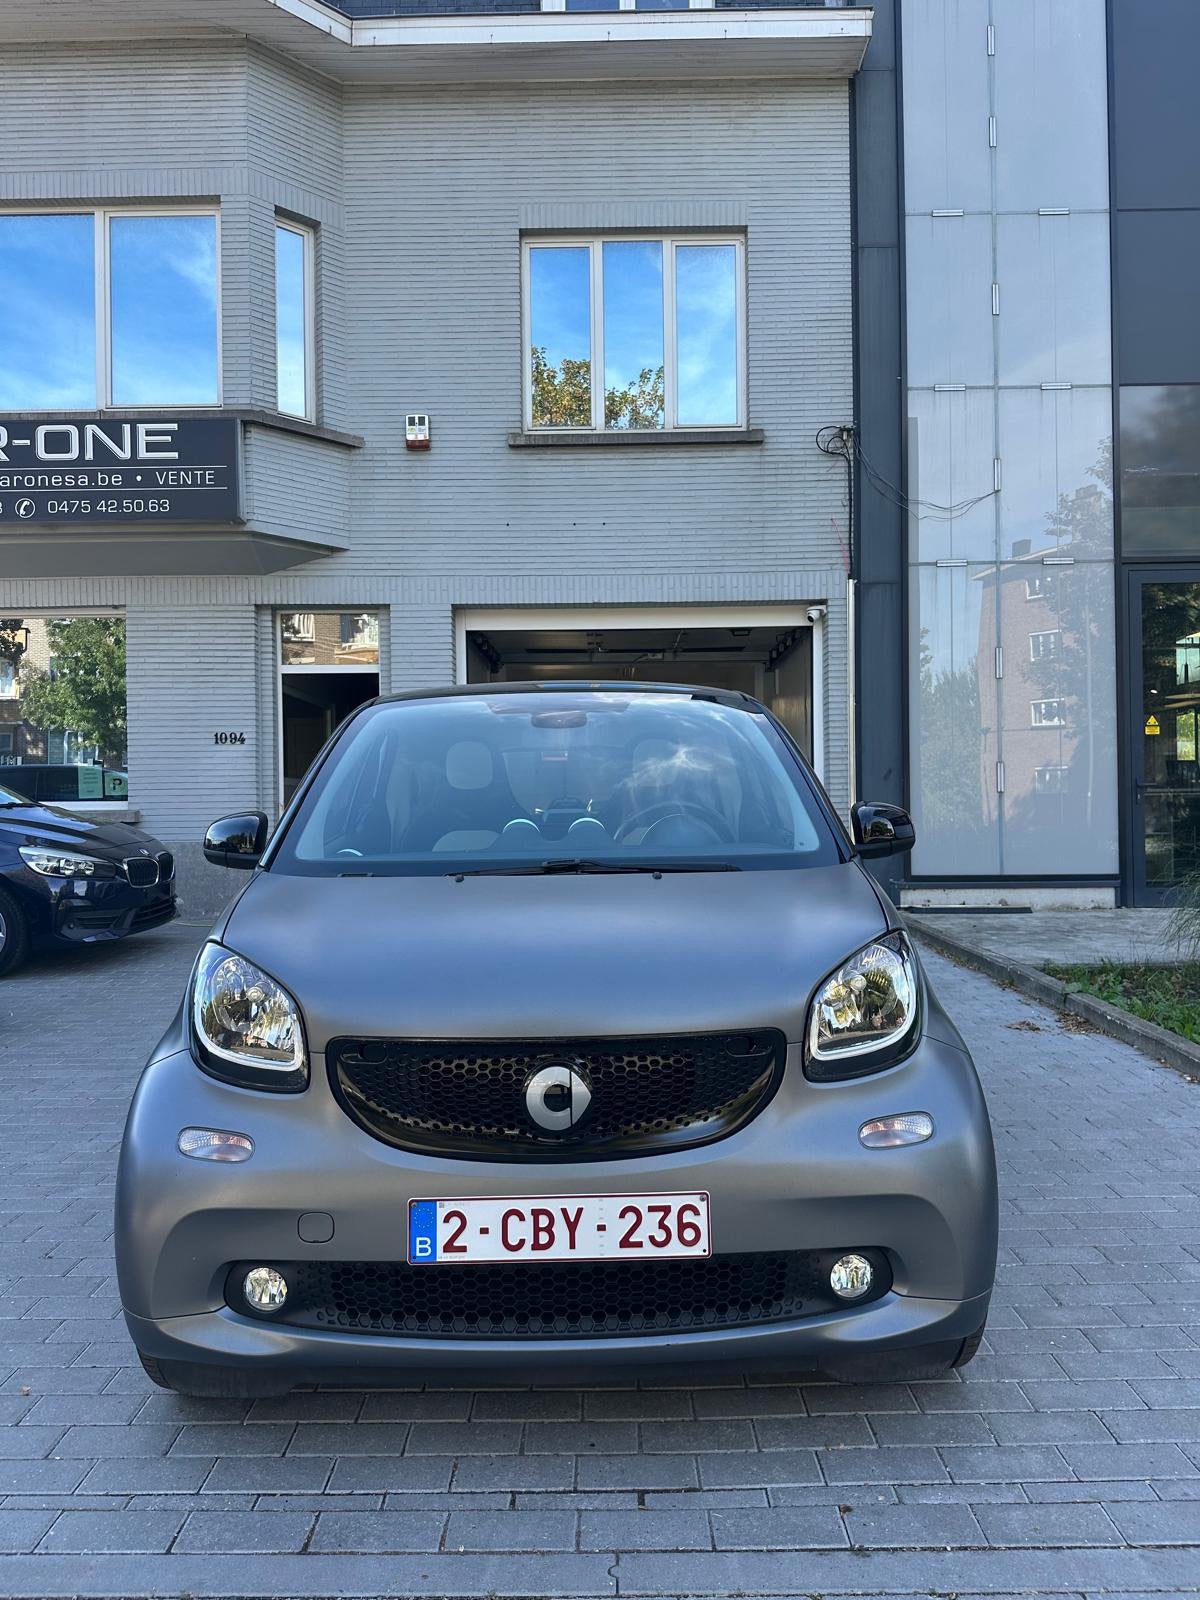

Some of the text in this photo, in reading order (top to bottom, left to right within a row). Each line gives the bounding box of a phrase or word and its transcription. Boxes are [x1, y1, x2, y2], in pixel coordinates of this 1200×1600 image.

[0, 424, 179, 462] -ONE
[155, 470, 215, 485] VENTE
[47, 499, 170, 514] 0475 42.50.63
[214, 732, 246, 745] 1094
[415, 1236, 432, 1257] B
